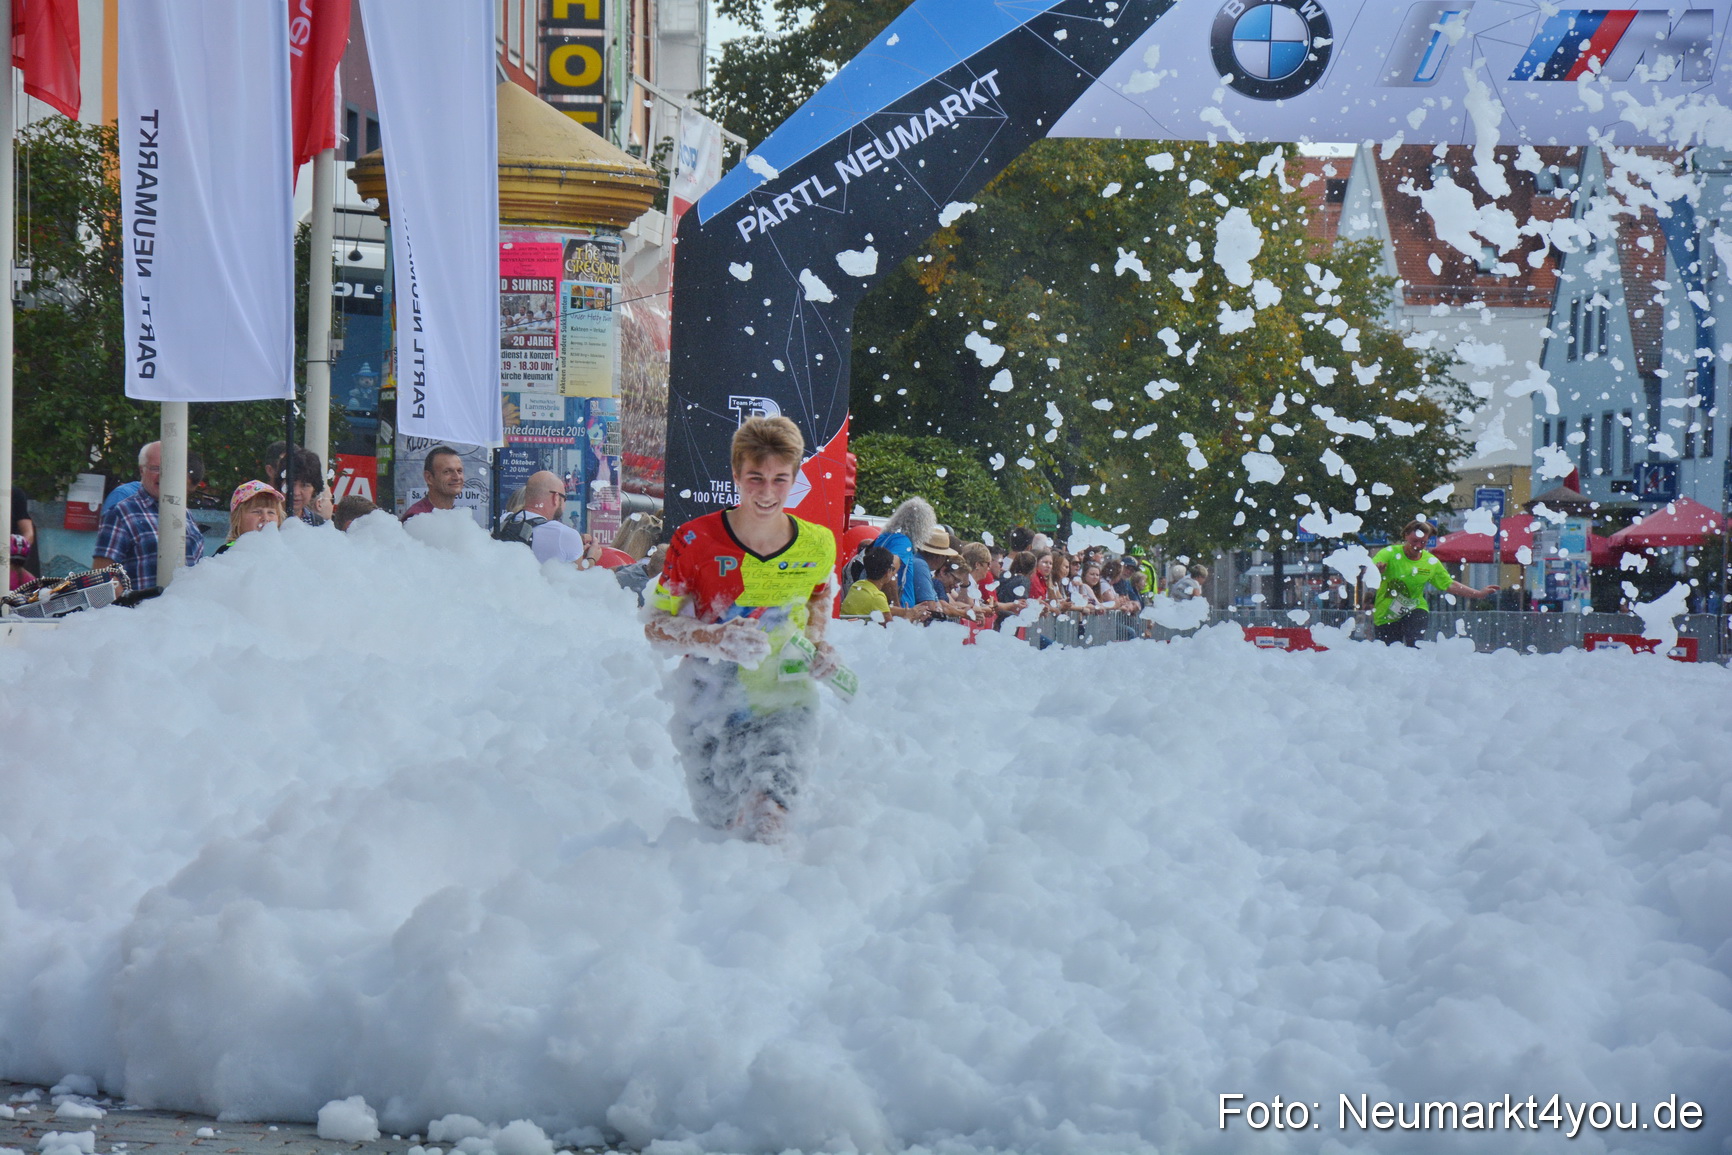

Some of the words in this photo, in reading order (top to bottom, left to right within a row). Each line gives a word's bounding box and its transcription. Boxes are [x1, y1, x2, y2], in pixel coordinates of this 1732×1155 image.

[1223, 0, 1326, 21] BW
[736, 174, 837, 243] PARTL
[834, 68, 1001, 185] NEUMARKT
[511, 279, 554, 292] SUNRISE
[527, 336, 554, 347] JAHRE
[529, 351, 554, 360] Konzert
[519, 361, 539, 371] 18.30
[540, 361, 553, 371] Uhr
[523, 372, 554, 381] Neumarkt
[566, 426, 586, 437] 2019
[709, 480, 732, 492] THE
[465, 491, 480, 499] Uhr
[692, 491, 710, 503] 100
